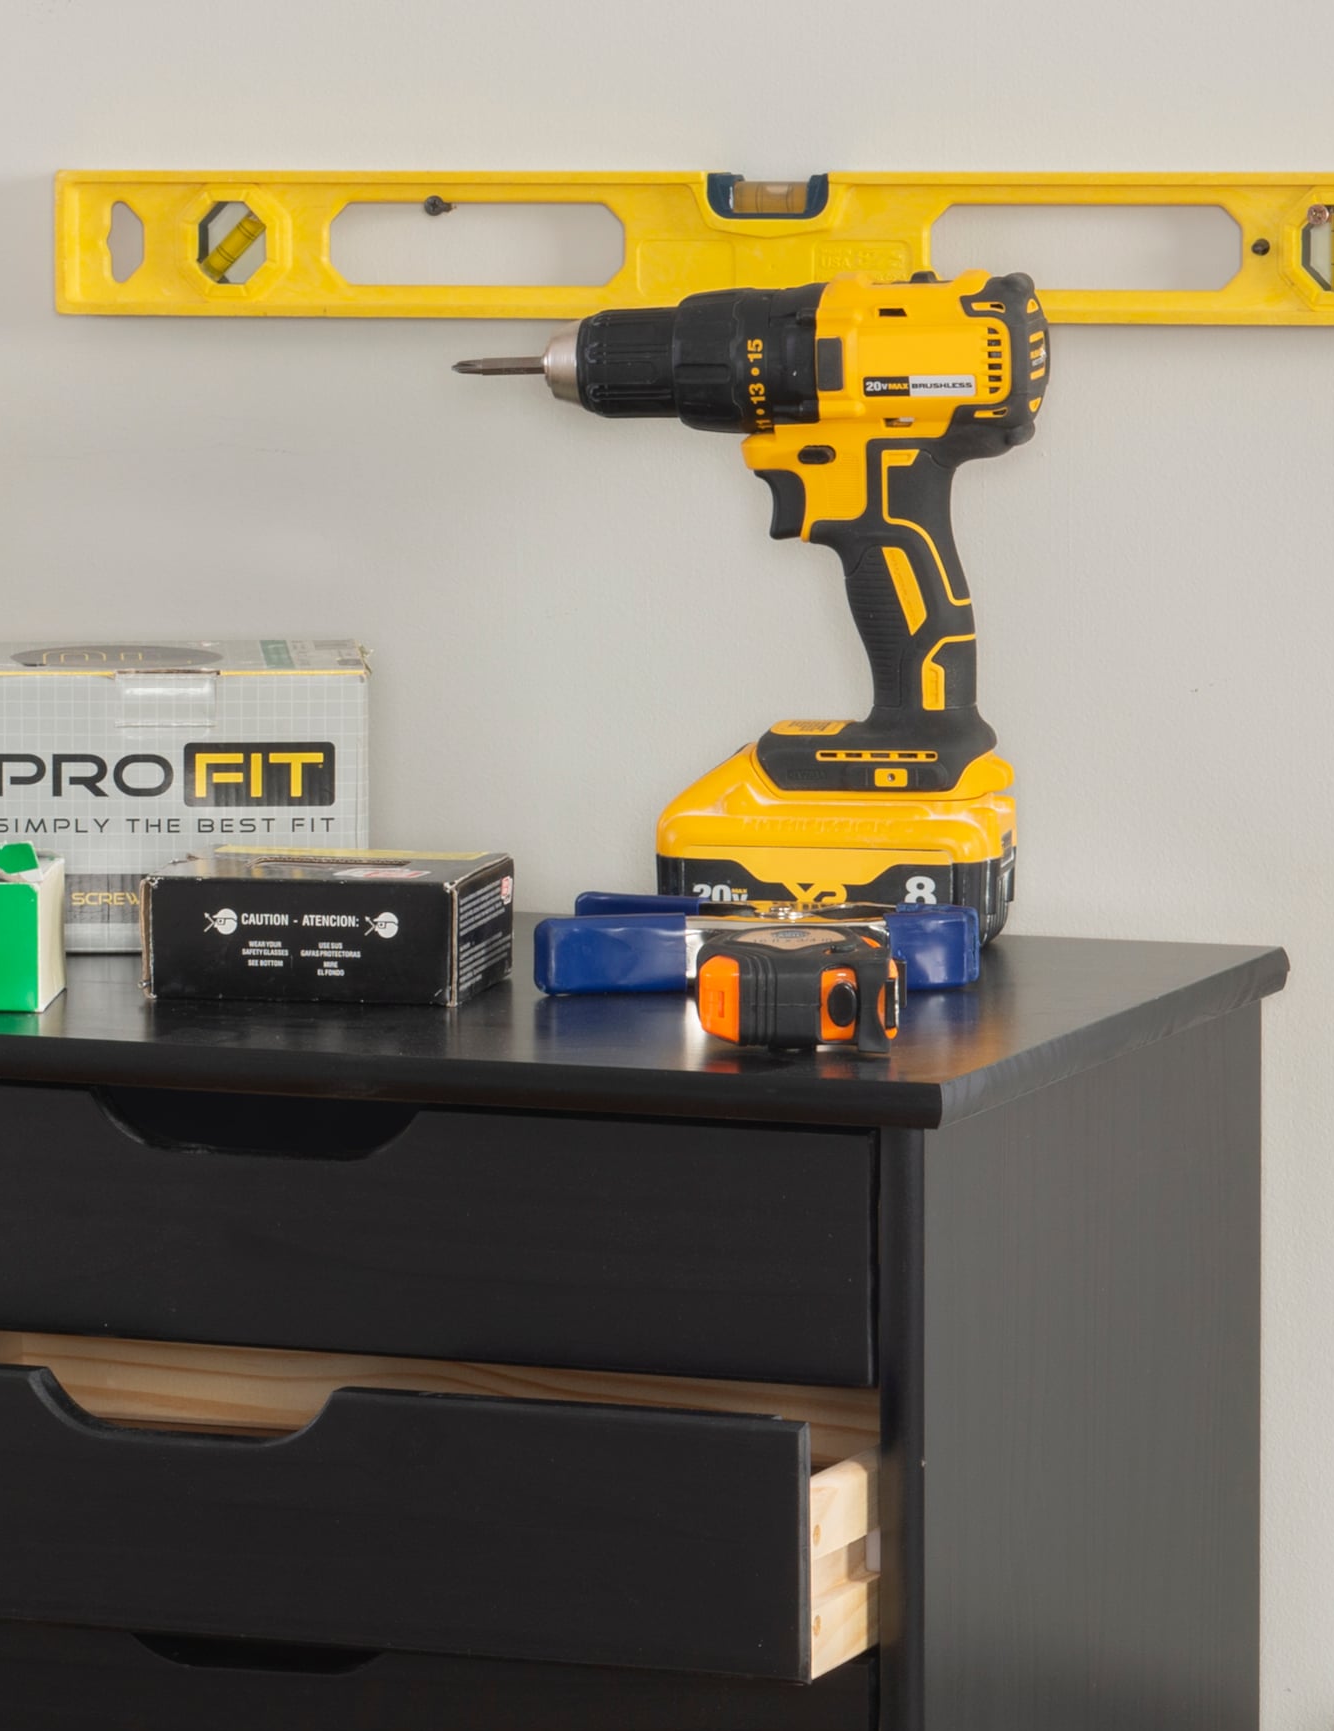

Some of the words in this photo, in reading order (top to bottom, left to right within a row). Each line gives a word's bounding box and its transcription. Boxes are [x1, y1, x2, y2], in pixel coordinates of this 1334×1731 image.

[747, 338, 764, 363] 15
[749, 383, 766, 404] 13
[911, 382, 973, 390] BRUSHLESS
[126, 818, 182, 834] THE
[197, 817, 276, 834] BEST
[291, 817, 336, 833] FIT
[241, 912, 289, 927] CAUTION
[302, 914, 359, 928] ATENCION:
[242, 948, 263, 956] SAFETY
[263, 949, 289, 957] GLASSES
